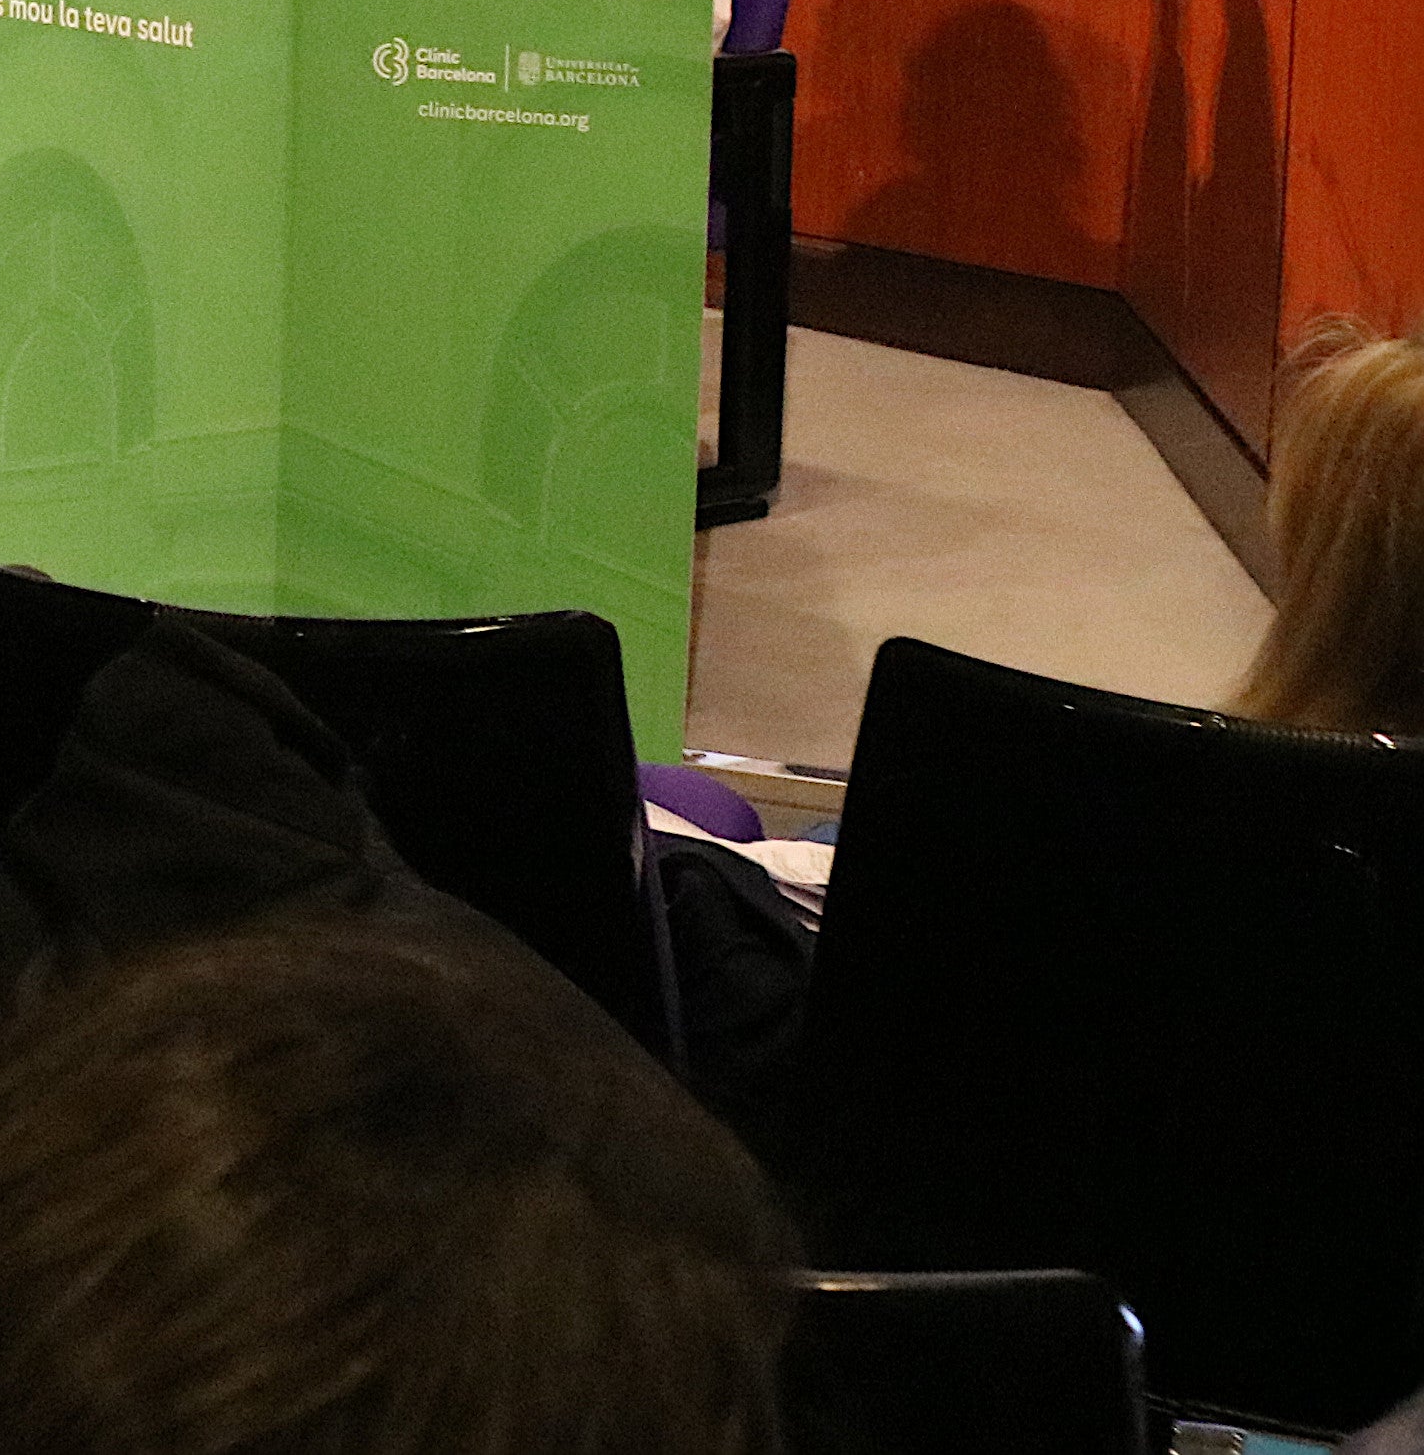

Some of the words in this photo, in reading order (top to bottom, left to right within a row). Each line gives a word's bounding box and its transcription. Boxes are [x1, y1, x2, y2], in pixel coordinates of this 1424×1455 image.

[59, 0, 79, 28] la
[84, 7, 132, 37] teva
[137, 16, 193, 47] salut
[415, 47, 461, 65] Clínic
[546, 57, 630, 71] UNIVERSITAT
[416, 65, 496, 84] Barcelona
[546, 70, 640, 87] BARCELONA
[419, 102, 590, 132] clinicbarcelona.org
